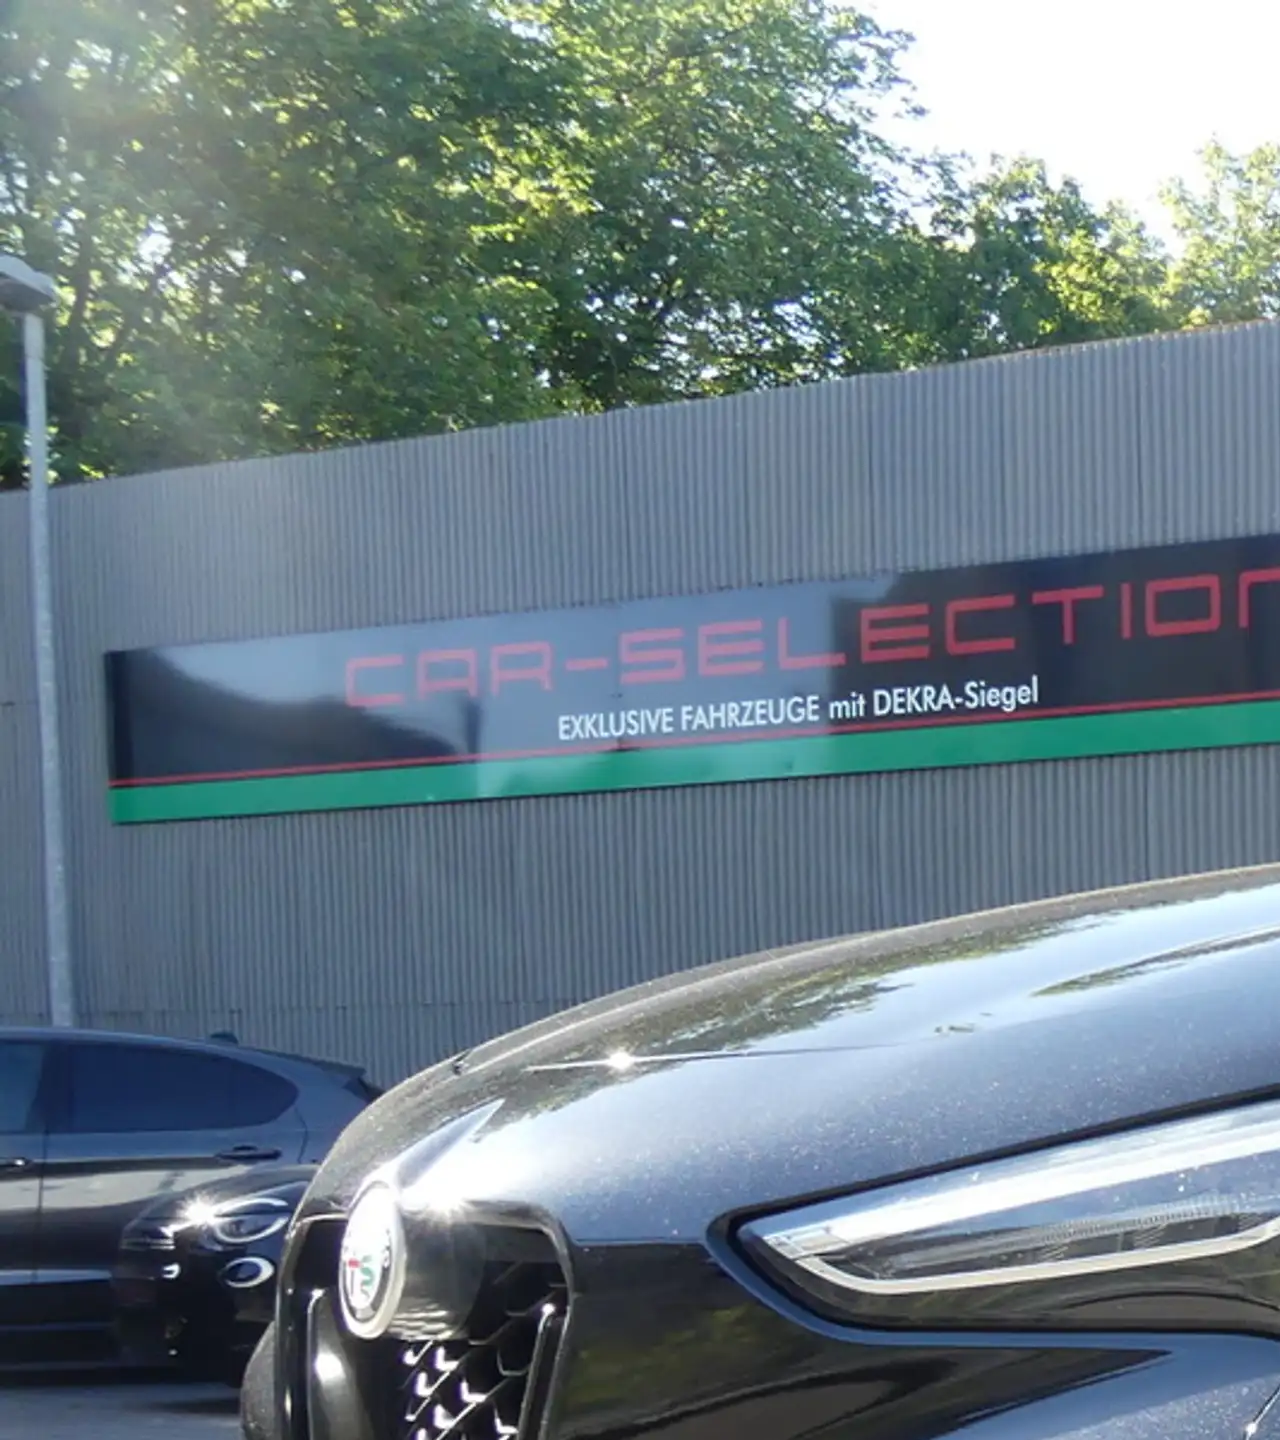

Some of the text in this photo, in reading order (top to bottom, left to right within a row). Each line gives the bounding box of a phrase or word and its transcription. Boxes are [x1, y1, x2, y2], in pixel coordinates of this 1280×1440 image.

[557, 675, 1039, 741] EXKLUSIVE FAHRZEUGE mit DEKRA-Siegel
